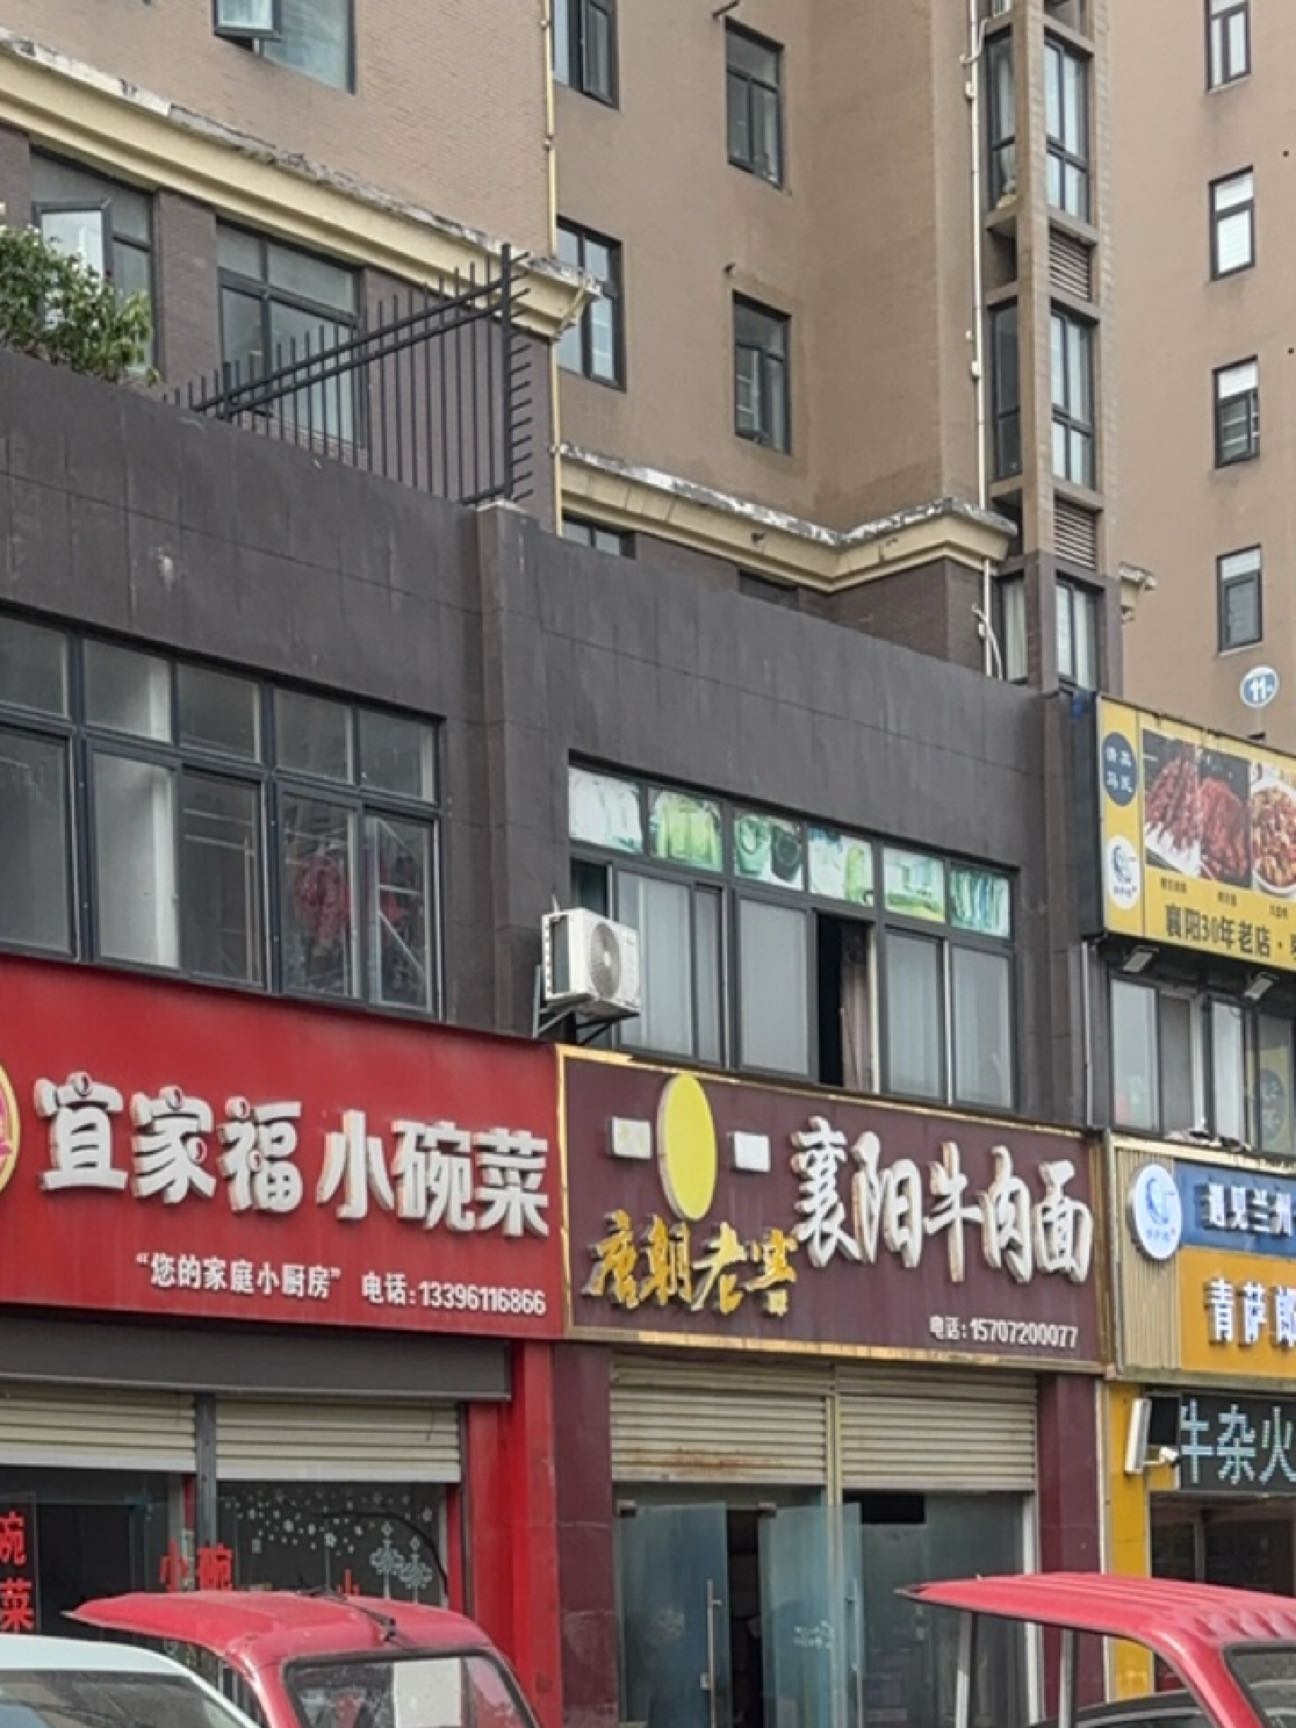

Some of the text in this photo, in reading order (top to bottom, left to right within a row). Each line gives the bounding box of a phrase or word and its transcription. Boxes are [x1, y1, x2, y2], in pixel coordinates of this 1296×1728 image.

[791, 1115, 1095, 1284] 襄阳牛肉面
